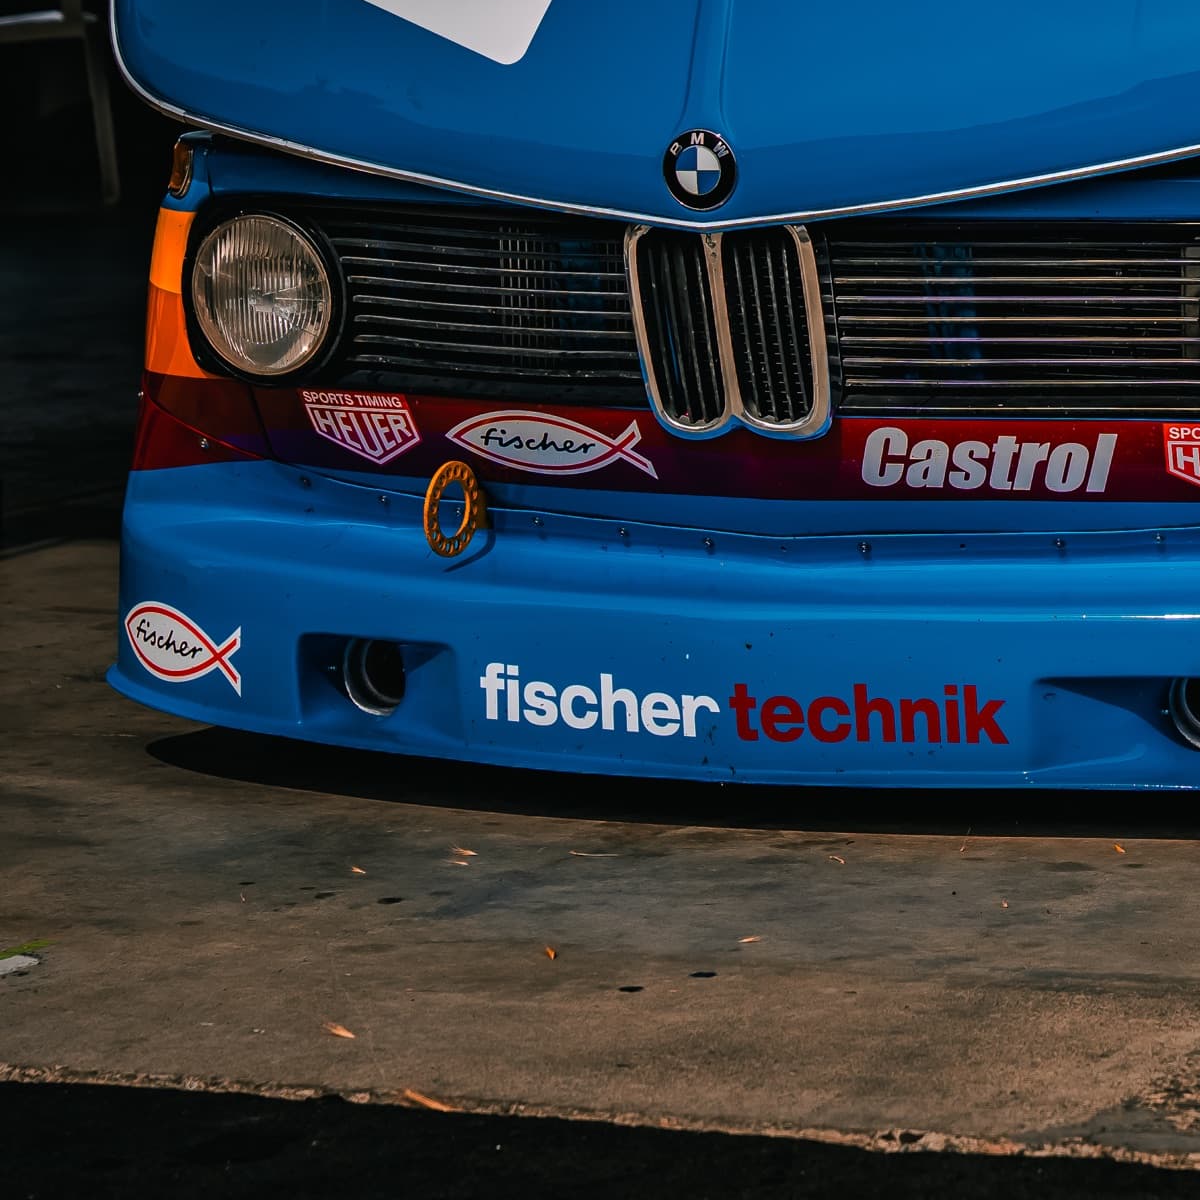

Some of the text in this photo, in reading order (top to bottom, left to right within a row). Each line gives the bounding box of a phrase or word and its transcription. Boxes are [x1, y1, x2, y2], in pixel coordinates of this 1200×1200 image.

[670, 132, 729, 158] BMW
[302, 391, 402, 408] SPORTS TIMING
[314, 409, 411, 459] HEUER
[481, 428, 596, 453] fischer
[861, 427, 1118, 493] Castrol
[136, 619, 203, 659] fischer
[480, 663, 1009, 744] fischer technik
